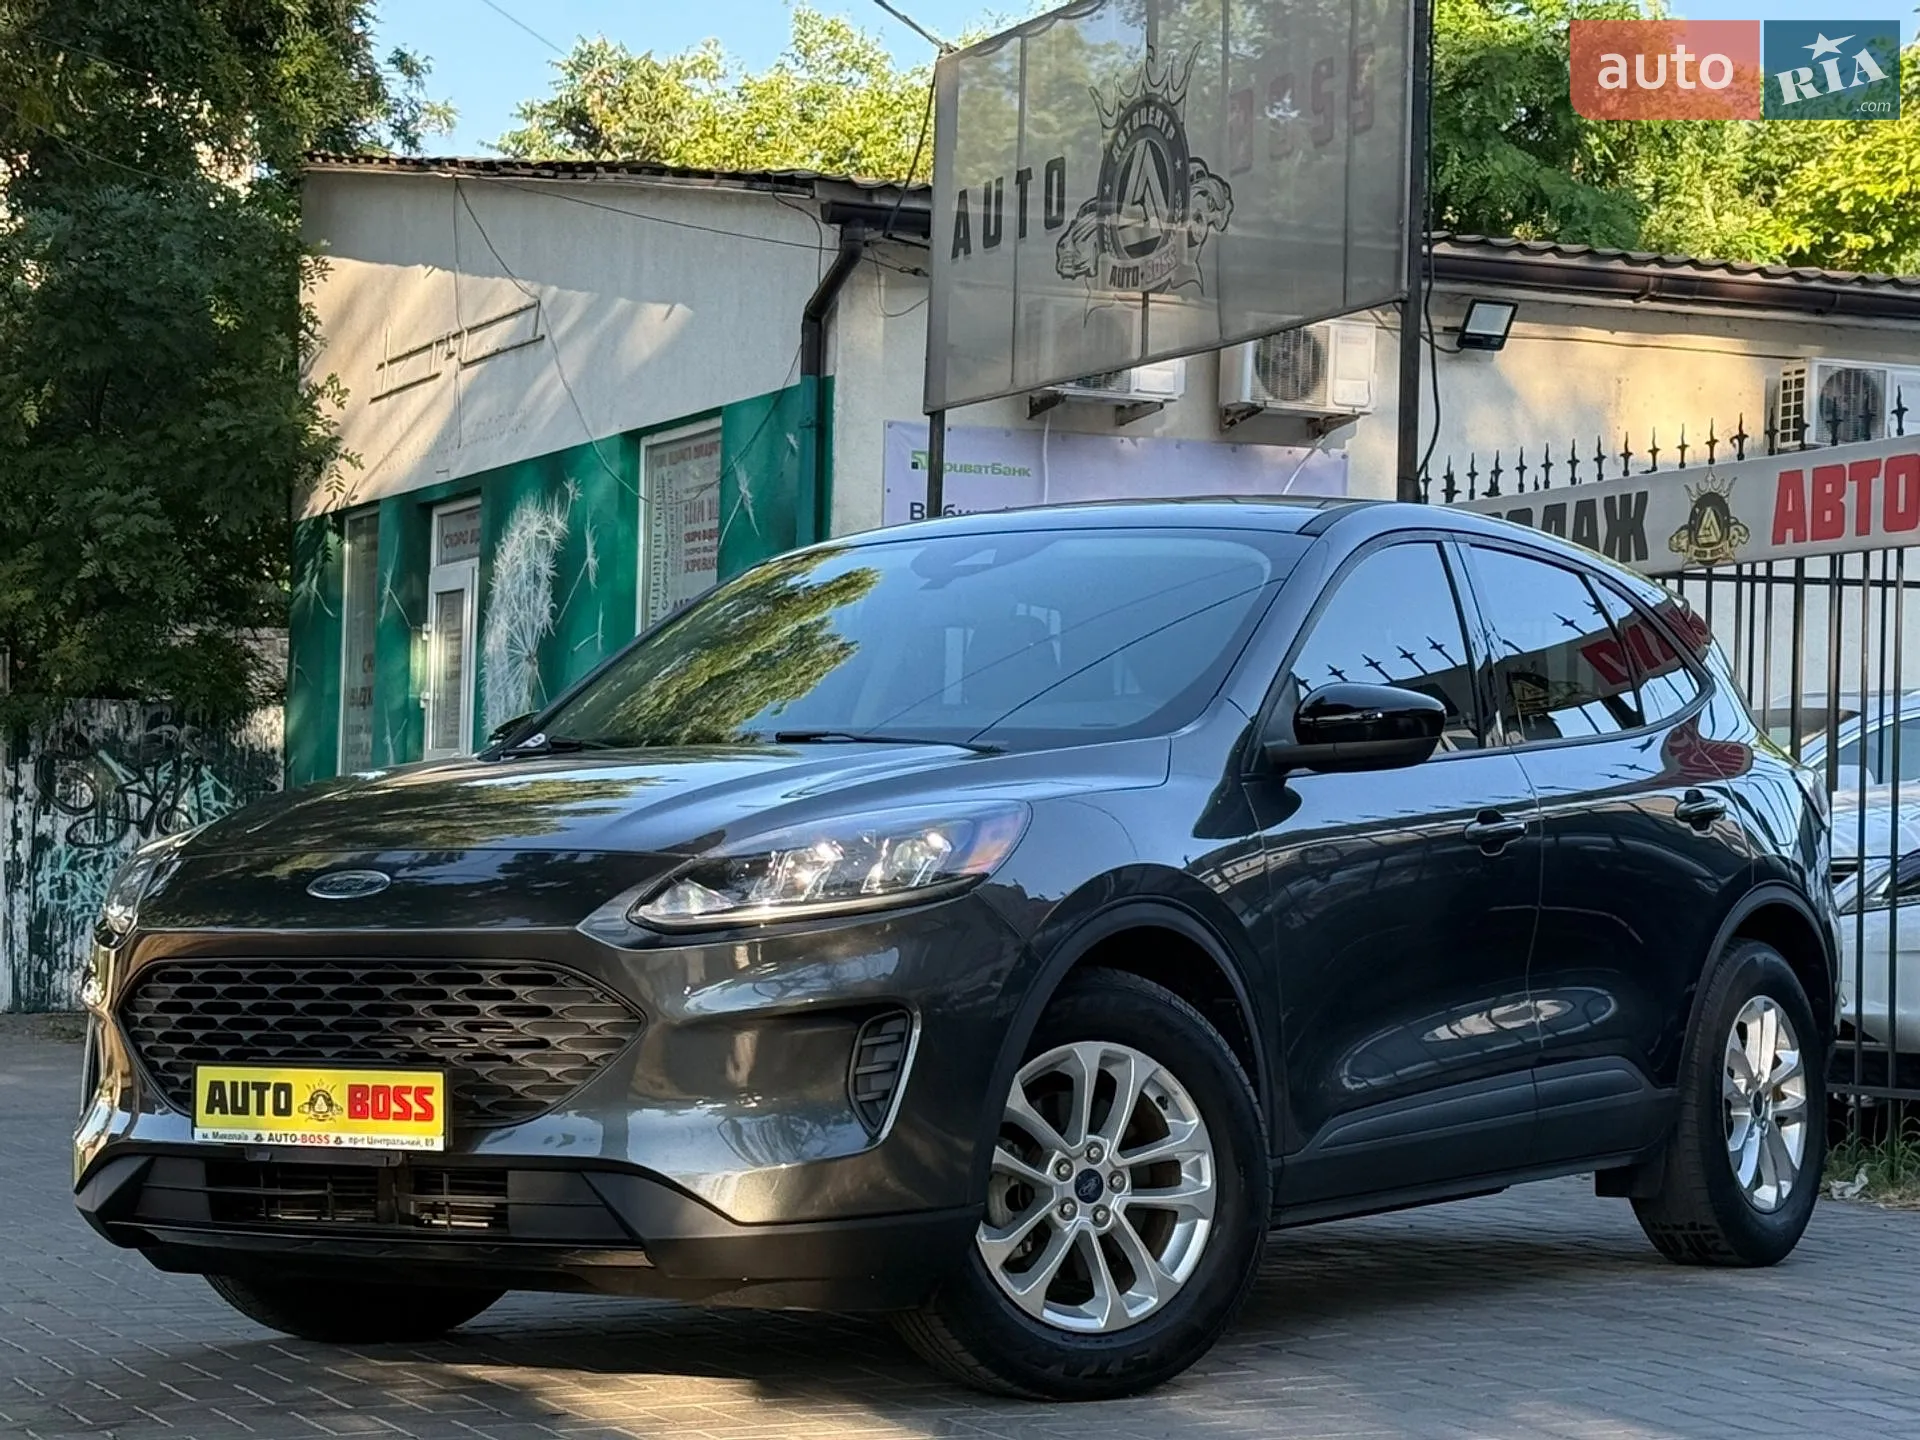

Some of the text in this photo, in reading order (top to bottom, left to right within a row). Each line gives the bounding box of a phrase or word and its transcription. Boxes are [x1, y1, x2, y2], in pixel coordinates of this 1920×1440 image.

[951, 156, 1065, 260] AUTO
[943, 461, 1032, 478] риватБанк
[1485, 453, 1920, 562] ДАЖ АВТО
[206, 1081, 435, 1122] AUTO BOSS
[267, 1133, 330, 1145] AUTO-BOSS
